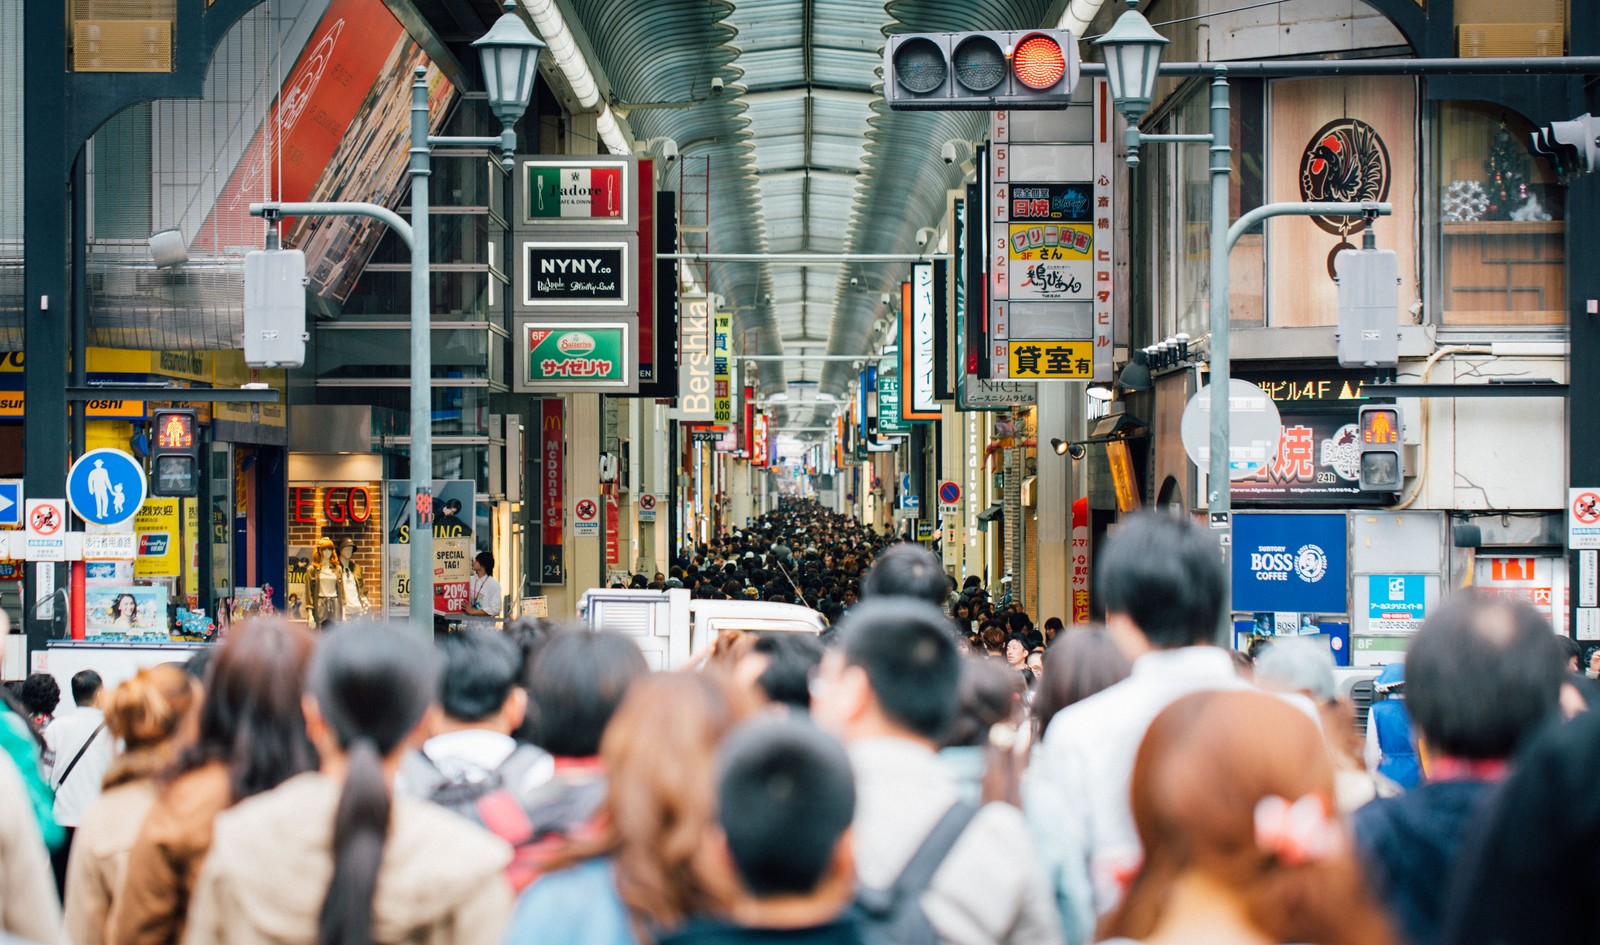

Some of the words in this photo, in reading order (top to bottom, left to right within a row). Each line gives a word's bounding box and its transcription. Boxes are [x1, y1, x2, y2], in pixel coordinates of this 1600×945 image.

[549, 184, 602, 197] J'adore
[1013, 188, 1049, 198] 完全個室
[1013, 199, 1049, 217] 日焼
[1097, 174, 1109, 229] 心斎橋
[1015, 228, 1089, 248] フリー麻雀
[1021, 252, 1033, 260] 3F
[1040, 248, 1062, 260] さん
[541, 259, 611, 273] NYNY.co
[1097, 249, 1110, 347] ヒロタビル
[532, 332, 545, 341] 6F
[683, 301, 710, 413] Bershka
[541, 358, 612, 377] サイゼリヤ
[981, 379, 1022, 392] NICE
[547, 441, 559, 527] McDonald's
[1317, 472, 1335, 483] 24h
[399, 525, 462, 544] SING
[436, 551, 465, 560] SPECIAL
[1250, 553, 1293, 571] BOSS
[444, 561, 460, 569] TAG!
[544, 565, 560, 575] 24
[1256, 572, 1288, 580] COFFEE
[443, 584, 468, 599] 20%
[447, 599, 464, 610] OFF
[1276, 621, 1296, 629] BOSS
[1358, 639, 1372, 649] 8F
